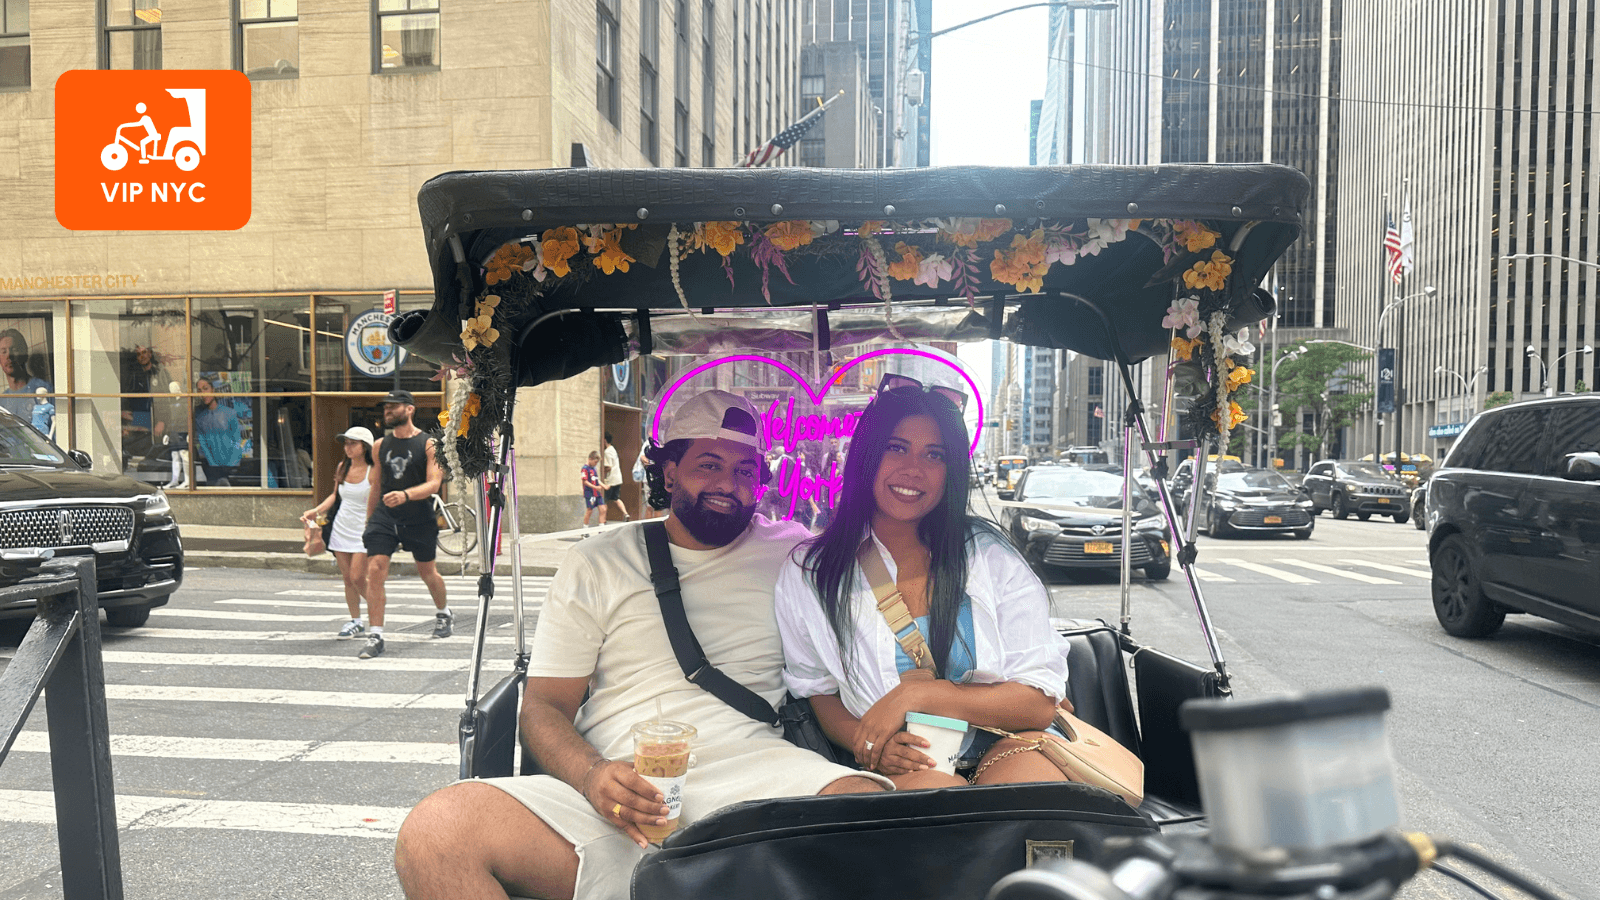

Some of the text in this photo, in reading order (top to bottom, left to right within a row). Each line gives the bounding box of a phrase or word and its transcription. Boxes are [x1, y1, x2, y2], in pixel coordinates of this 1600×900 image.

[0, 274, 140, 290] MANCHESTER CITY
[351, 313, 393, 336] MANCHES
[778, 457, 844, 521] York
